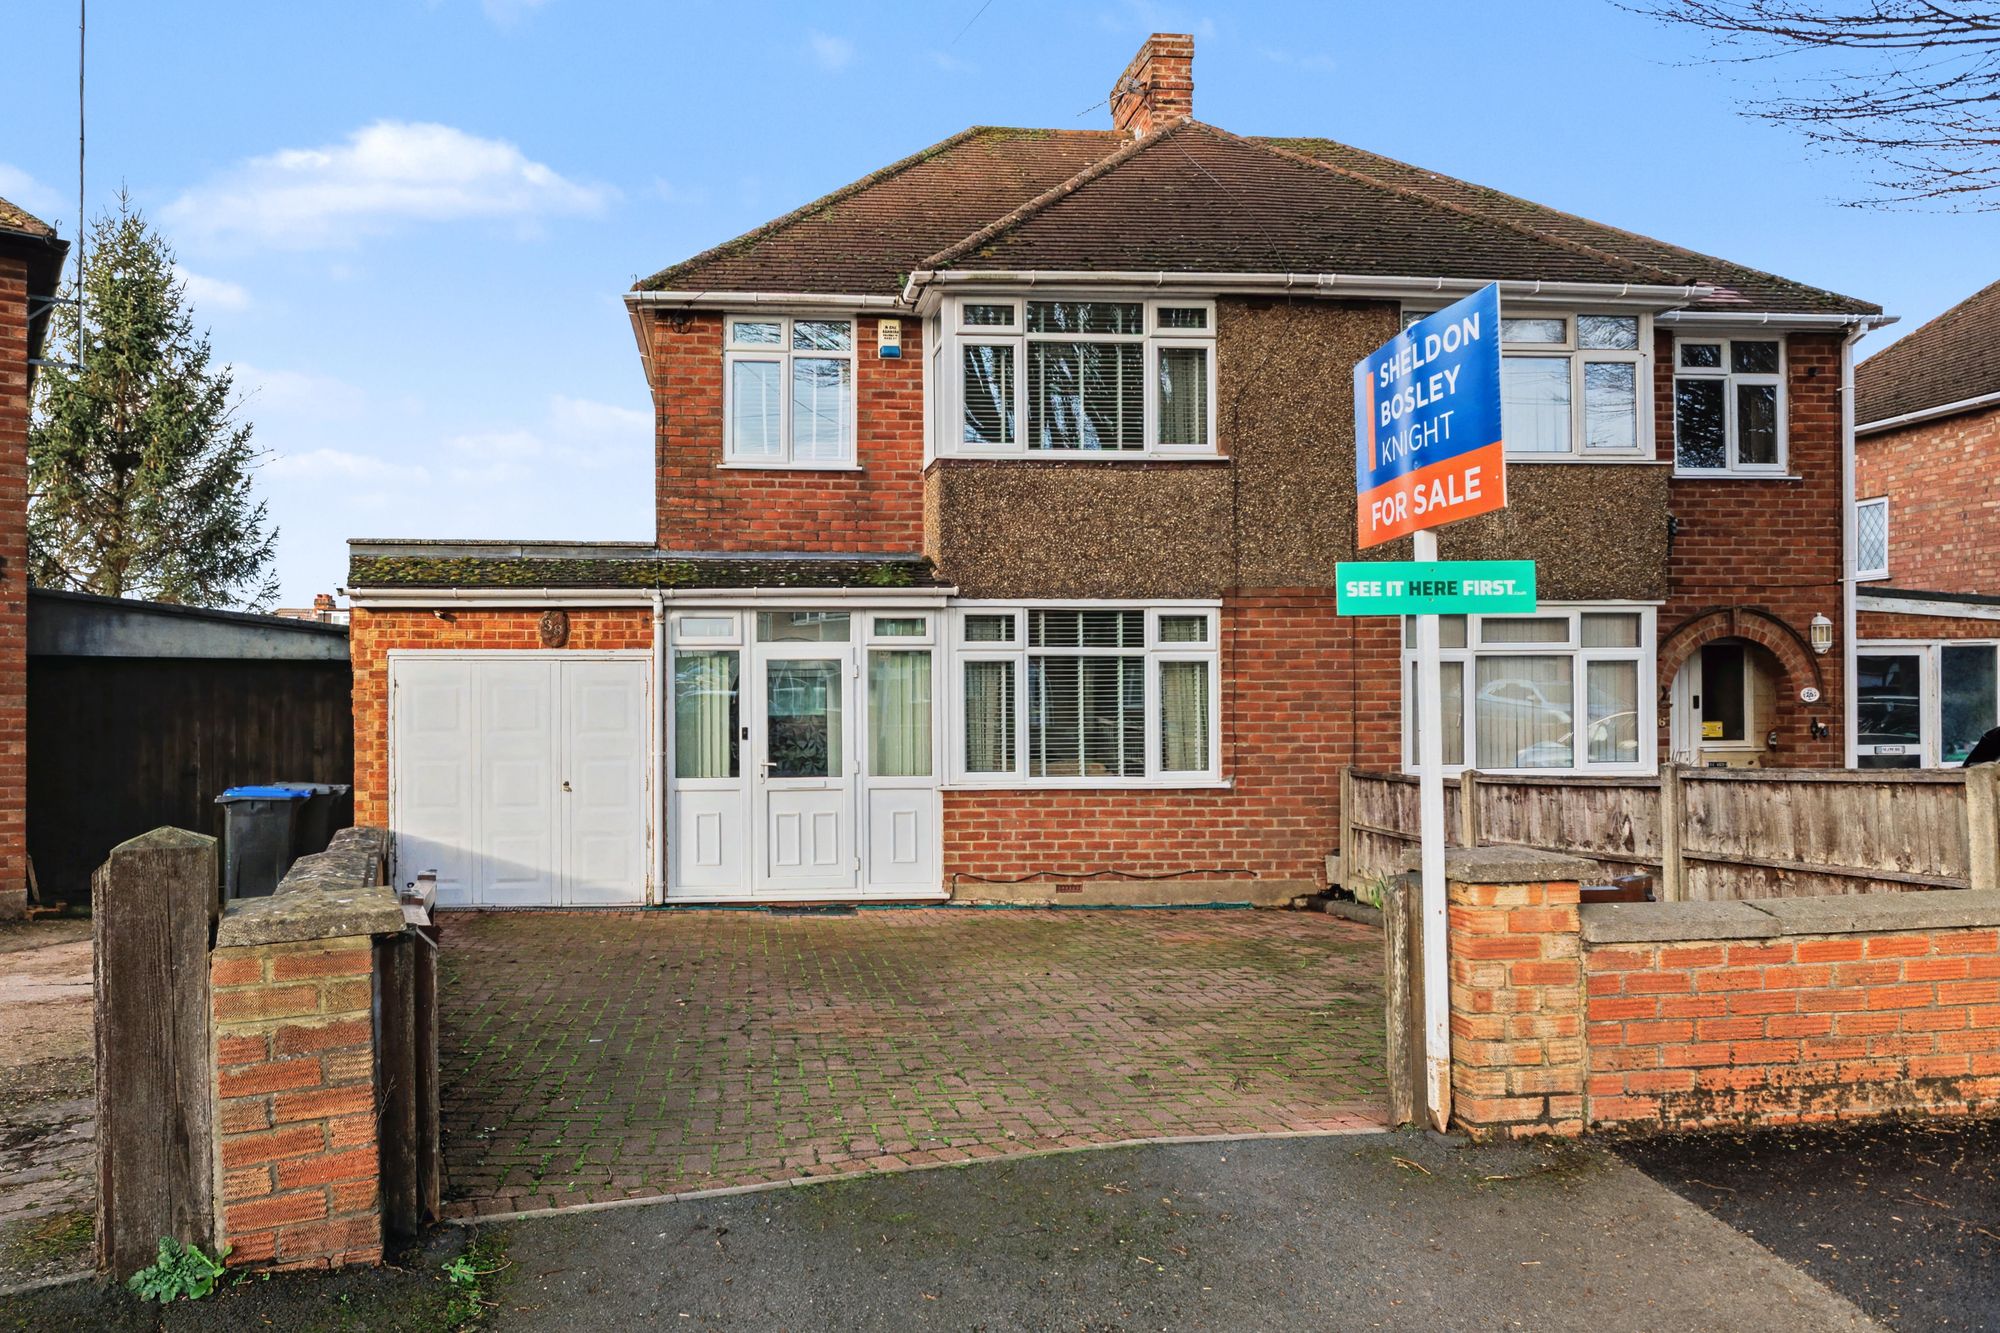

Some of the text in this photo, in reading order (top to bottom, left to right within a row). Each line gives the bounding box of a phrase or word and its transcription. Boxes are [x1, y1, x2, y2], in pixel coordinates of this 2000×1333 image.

[1380, 312, 1480, 388] SHELDON
[1381, 364, 1461, 427] BOSLEY
[1382, 410, 1454, 466] KNIGHT
[1372, 465, 1482, 531] FOR SALE
[1346, 580, 1382, 597] SEE
[1386, 580, 1404, 597] IT
[1409, 580, 1458, 597] HERE
[544, 619, 562, 636] 38
